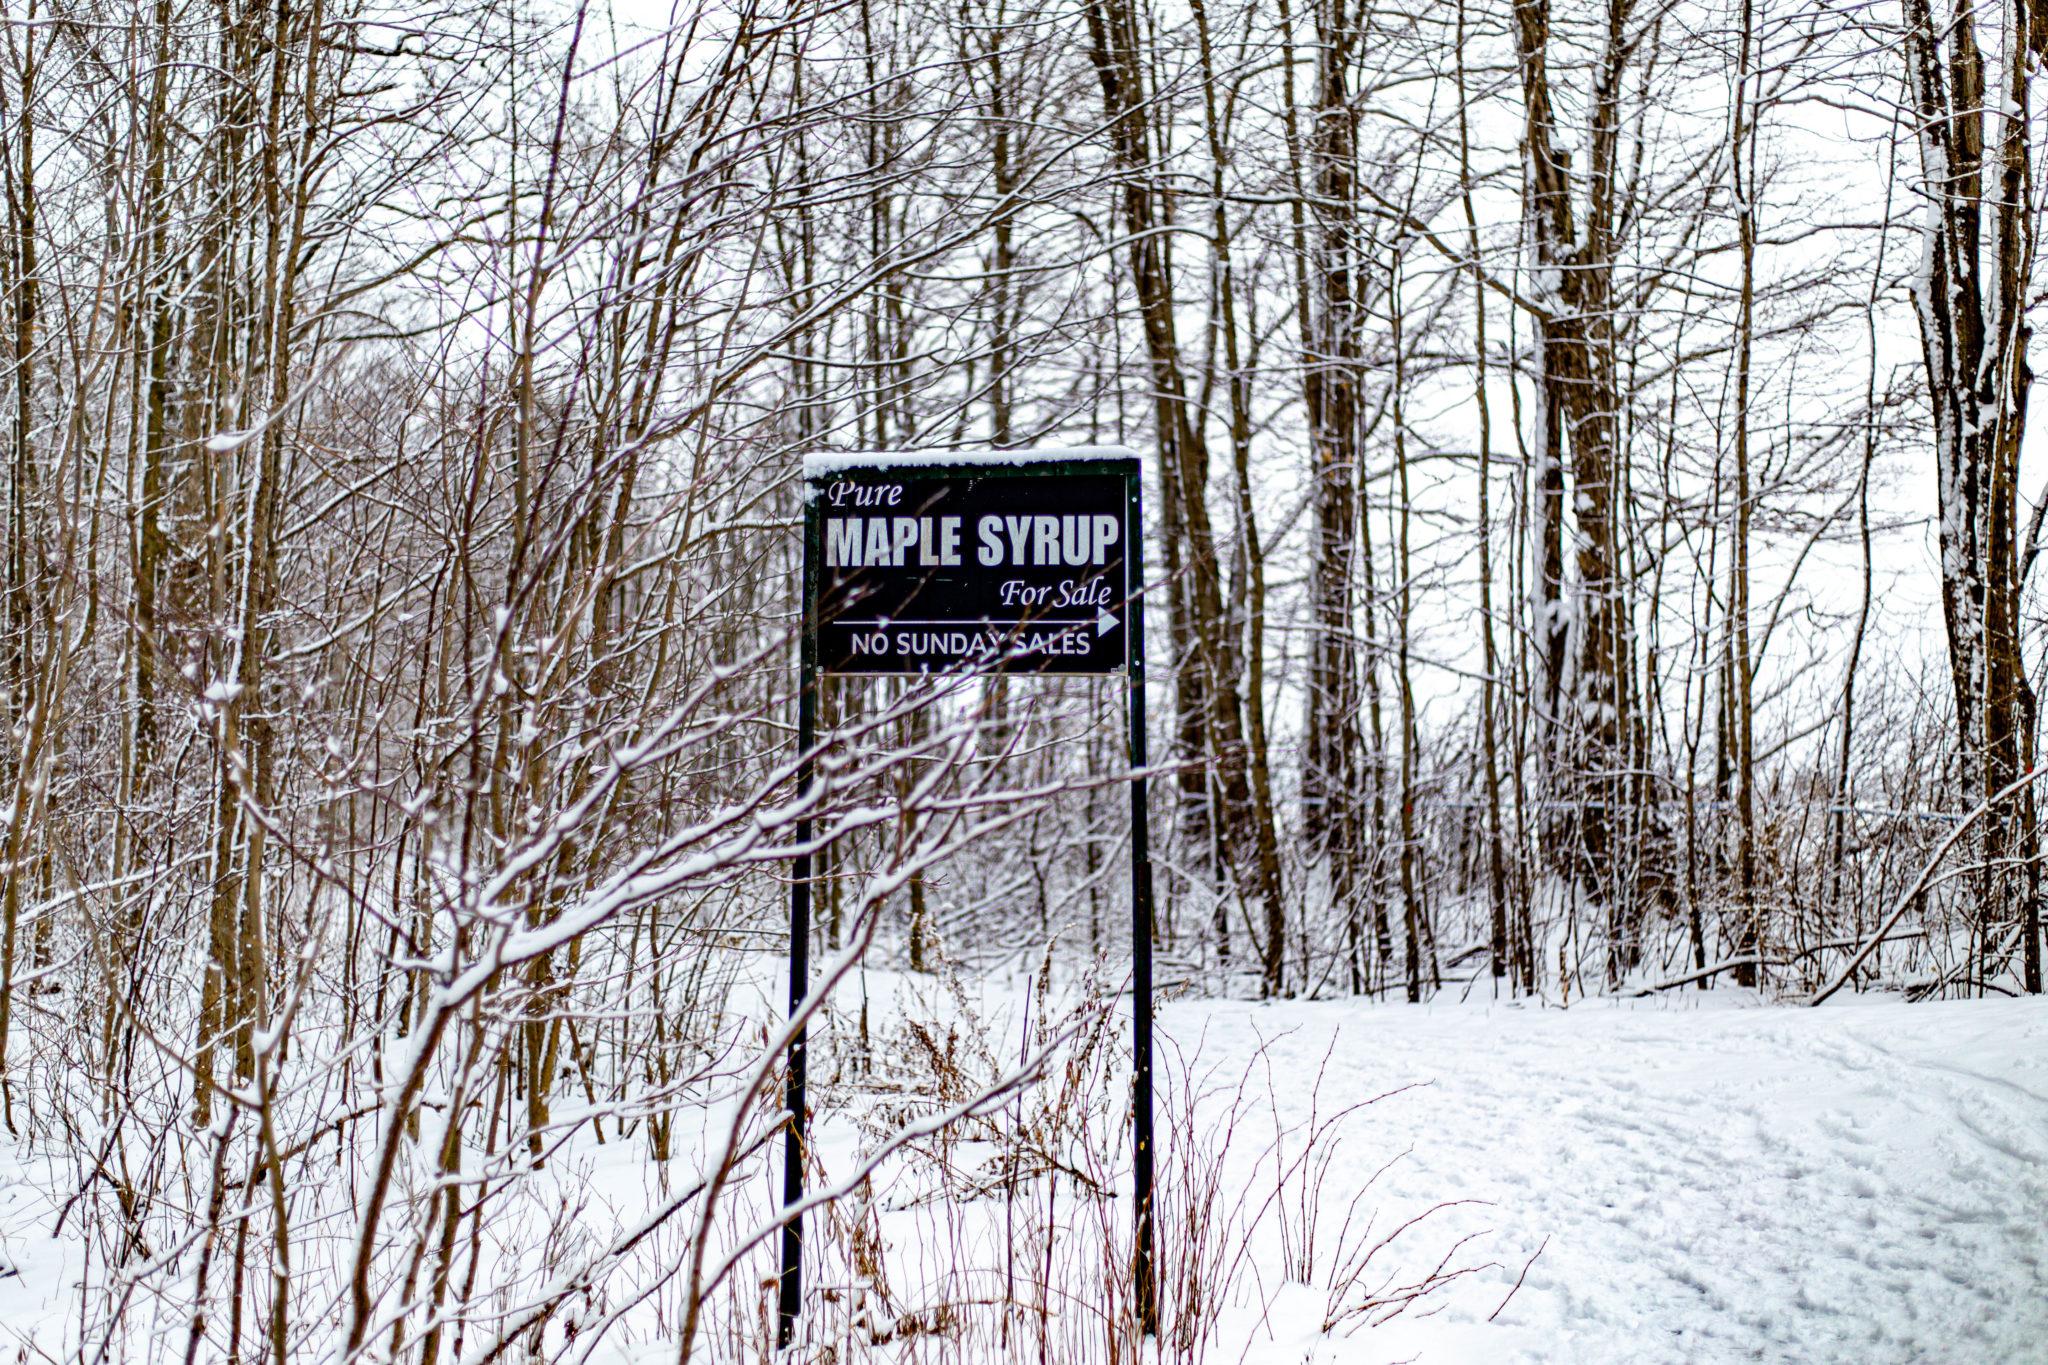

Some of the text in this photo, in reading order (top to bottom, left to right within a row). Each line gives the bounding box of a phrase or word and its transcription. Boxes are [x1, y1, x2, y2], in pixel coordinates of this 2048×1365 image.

[828, 480, 902, 507] Pure
[826, 515, 1119, 567] MAPLE SYRUP
[1000, 576, 1112, 608] For Sale
[852, 632, 1091, 655] NO SUNDAY SALES
